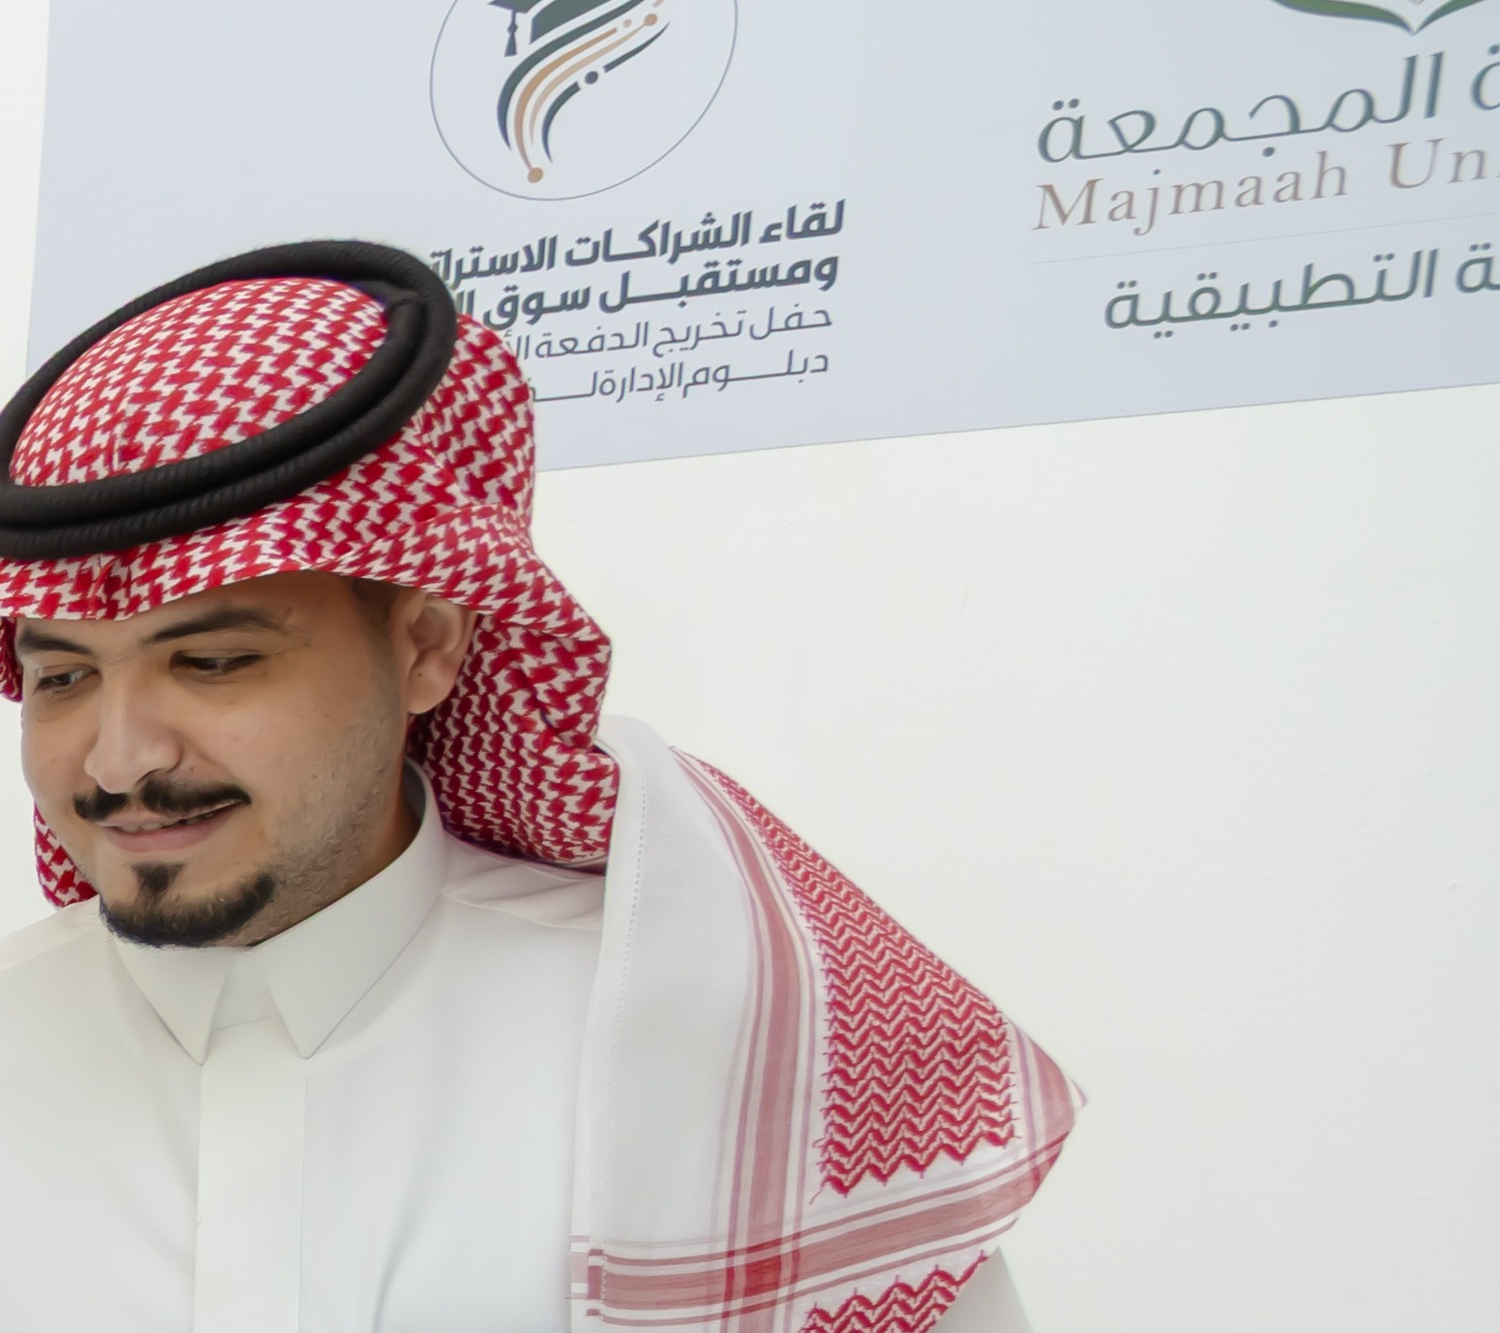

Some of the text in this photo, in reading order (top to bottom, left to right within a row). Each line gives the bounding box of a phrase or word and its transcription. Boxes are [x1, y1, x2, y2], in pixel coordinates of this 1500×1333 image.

[1037, 49, 1446, 165] المجمعة
[1031, 148, 1349, 237] Majmaah
[564, 209, 754, 267] الشراكات
[758, 198, 846, 246] لقاء
[482, 284, 592, 333] سوق
[599, 254, 841, 314] ومستقبل
[1104, 248, 1440, 340] التطبيقية
[534, 320, 651, 360] الدفعة
[652, 310, 749, 358] تخريج
[749, 303, 833, 341] حفل
[682, 349, 831, 400] دبلوم
